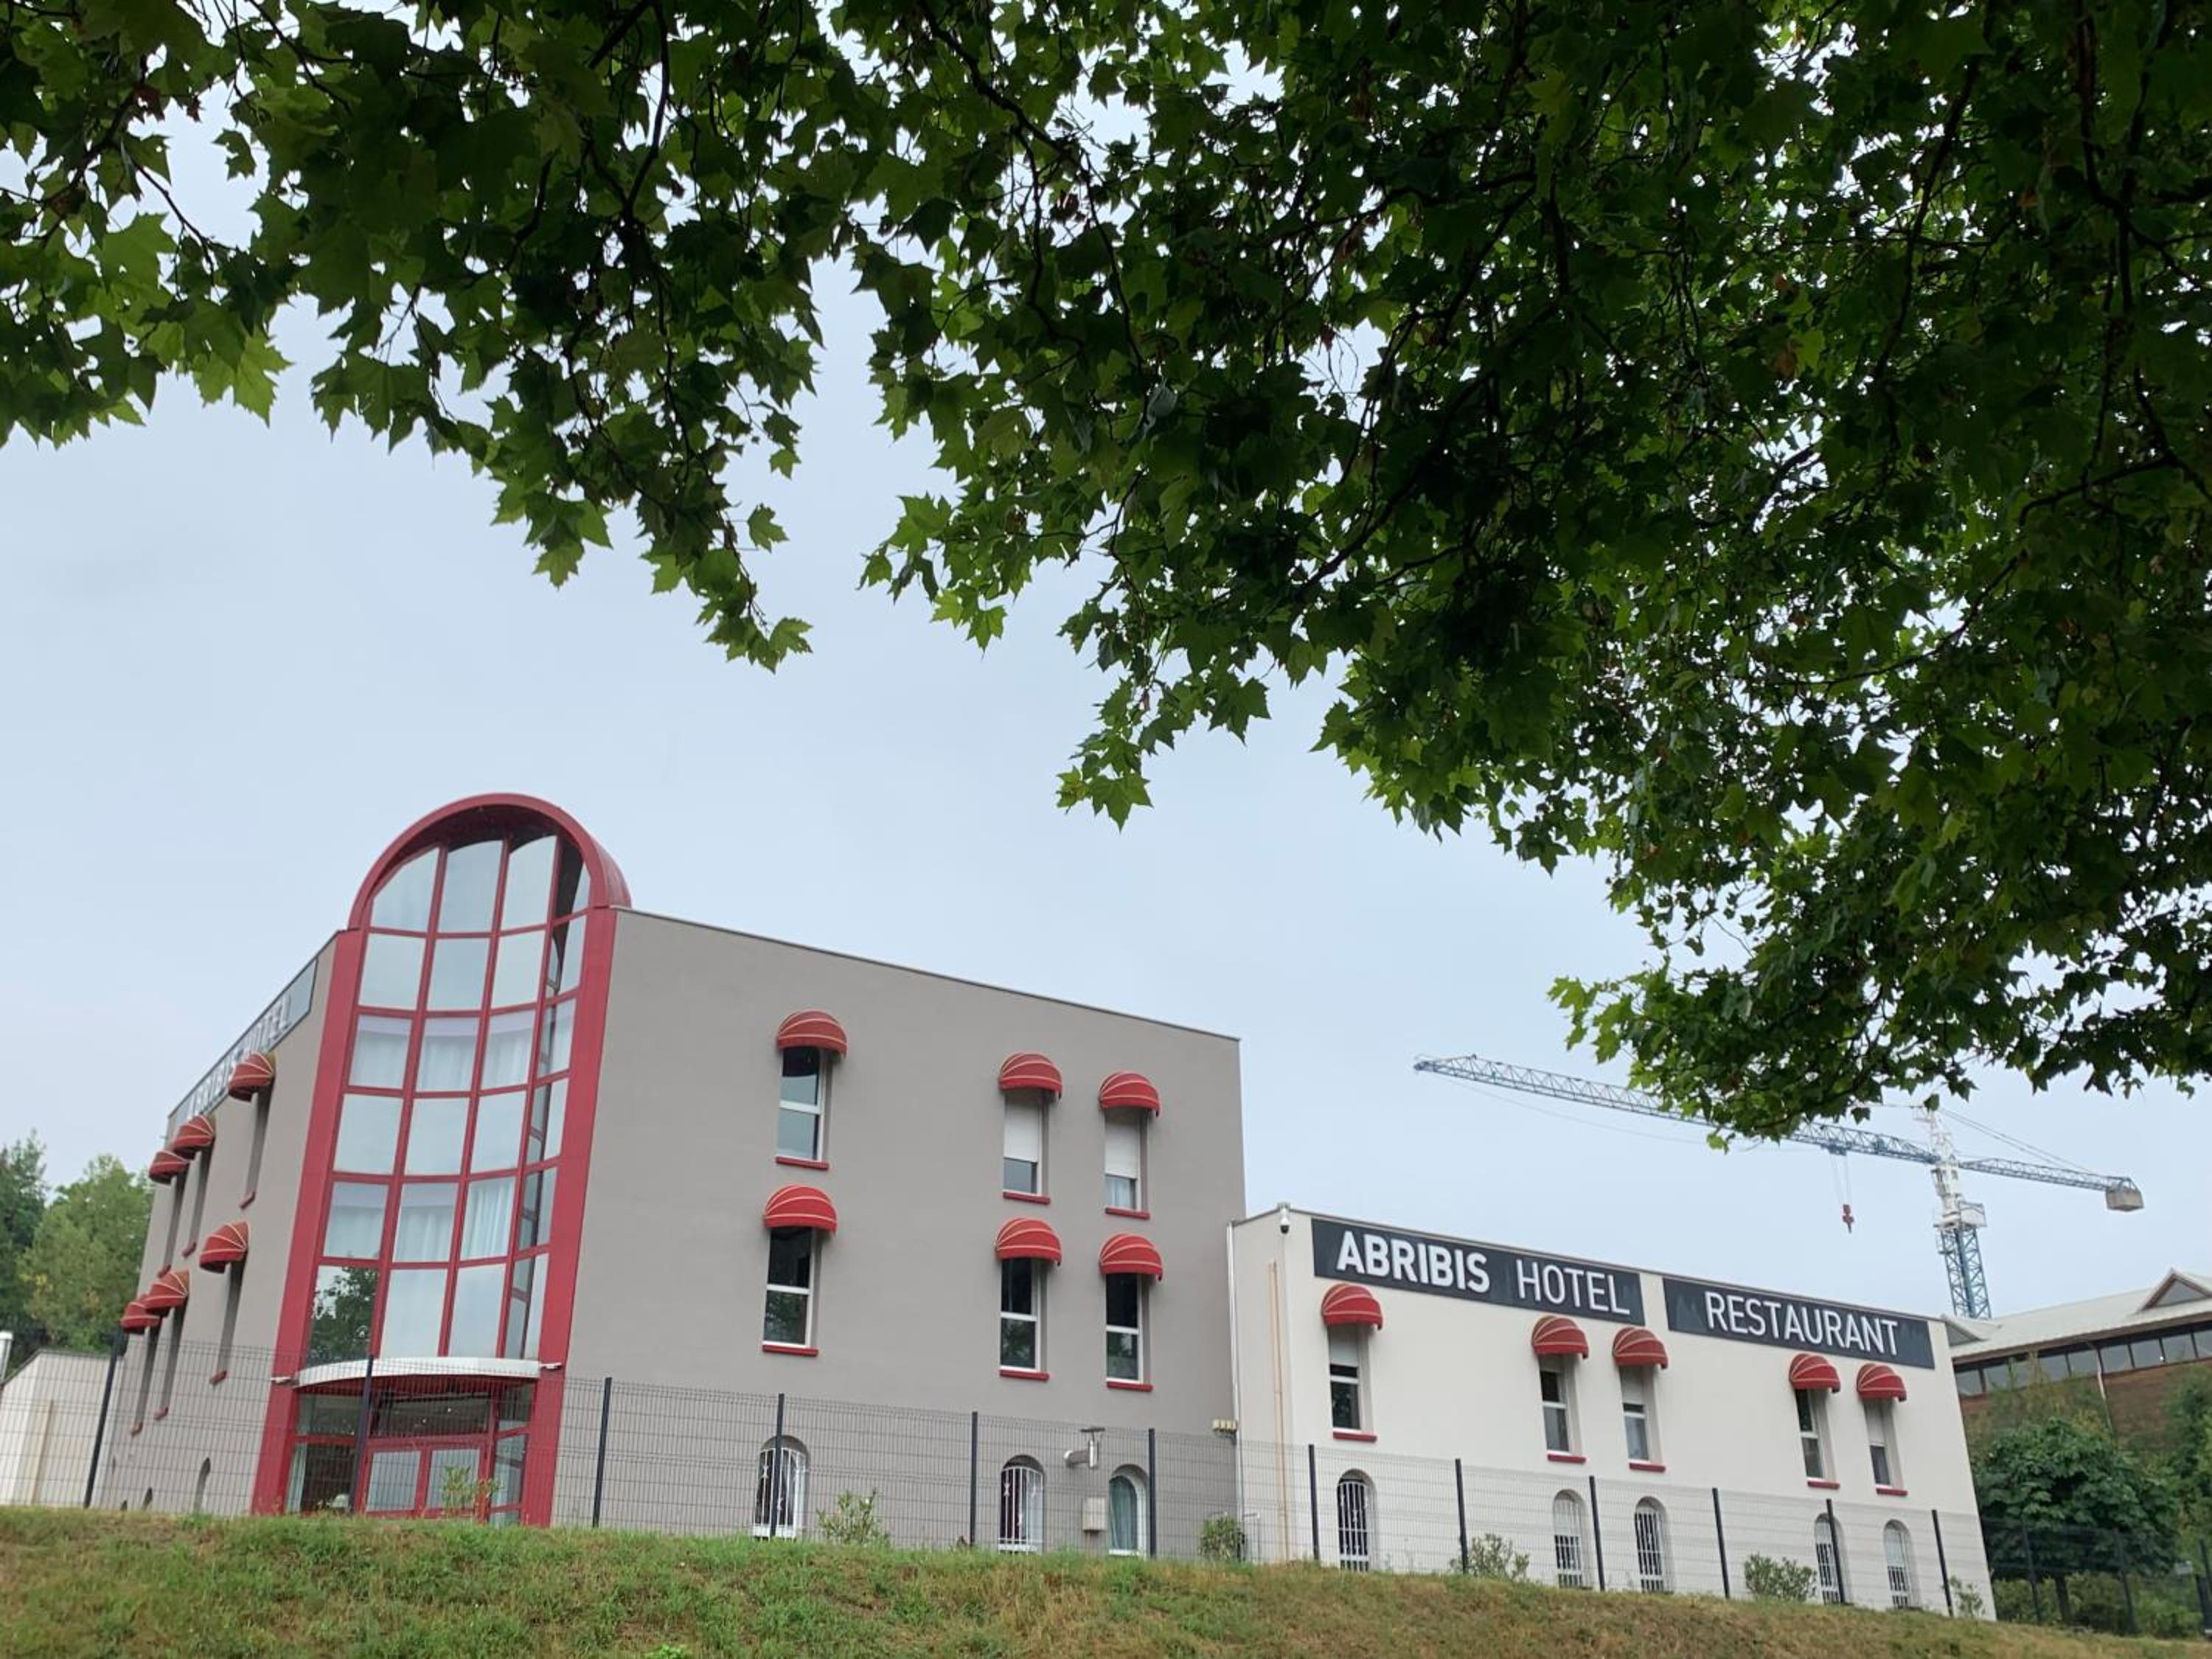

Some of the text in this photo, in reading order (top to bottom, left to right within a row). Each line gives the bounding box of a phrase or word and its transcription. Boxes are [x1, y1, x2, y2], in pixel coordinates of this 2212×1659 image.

[1336, 1231, 1630, 1315] ABRIBIS HOTEL
[1704, 1291, 1899, 1356] RESTAURANT
